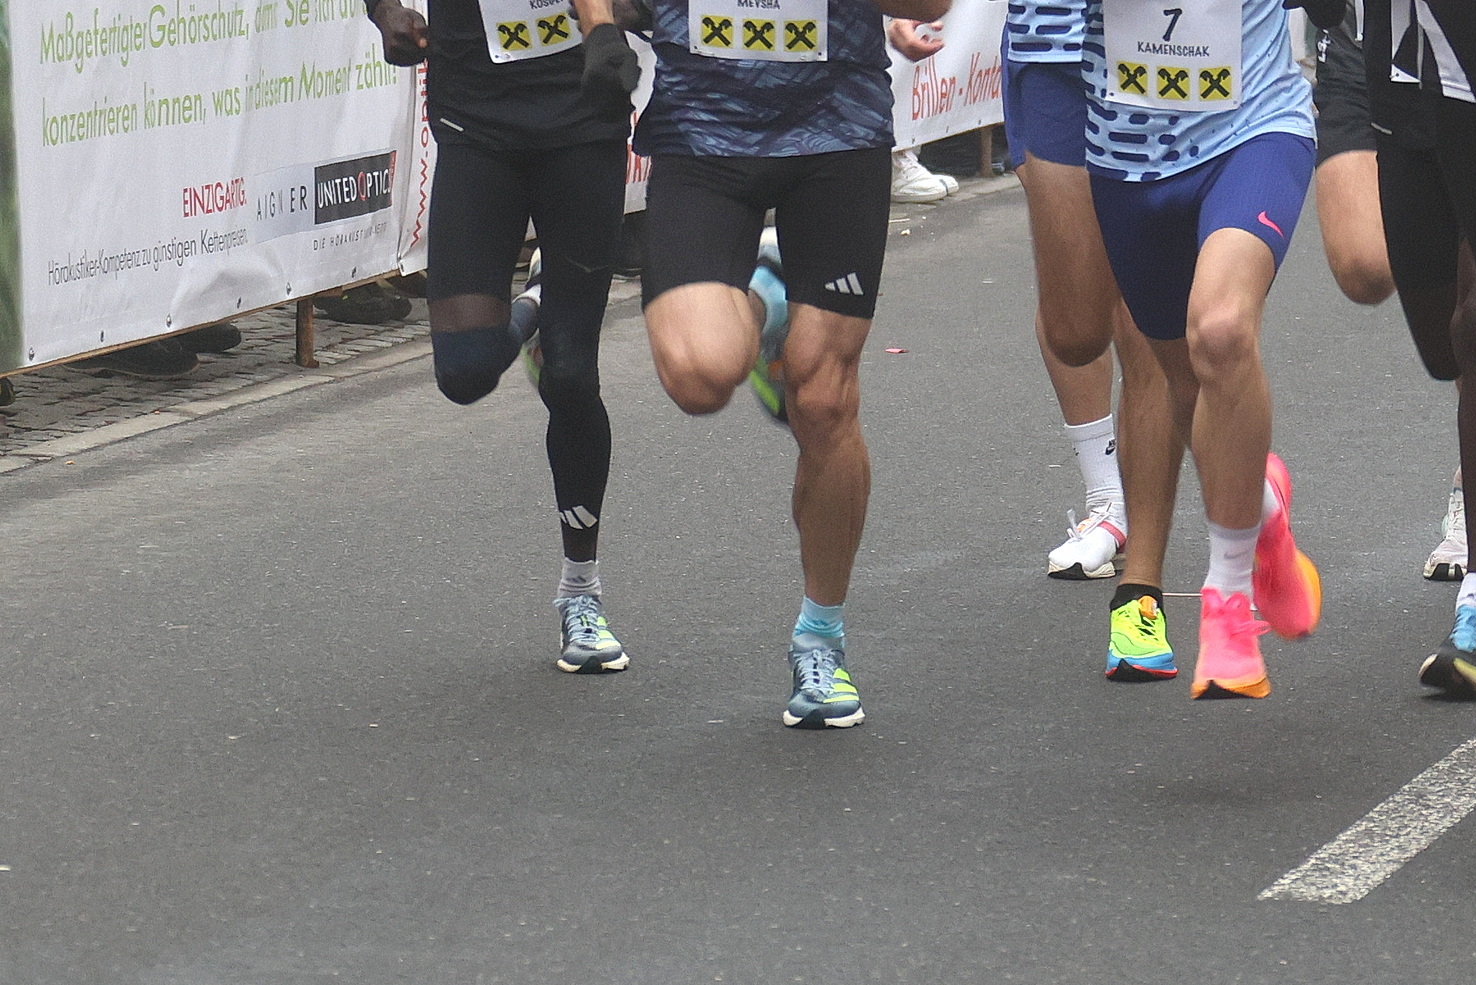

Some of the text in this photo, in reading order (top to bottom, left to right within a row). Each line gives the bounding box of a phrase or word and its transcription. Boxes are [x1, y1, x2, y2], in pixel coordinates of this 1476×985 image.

[1162, 8, 1183, 42] 7
[1137, 41, 1210, 57] KAMENSCHAK
[42, 96, 138, 147] konzentrieren
[212, 86, 241, 117] was
[298, 59, 351, 101] Moment
[911, 55, 956, 121] Brillen
[256, 185, 309, 222] AIGNER
[142, 248, 152, 266] zu
